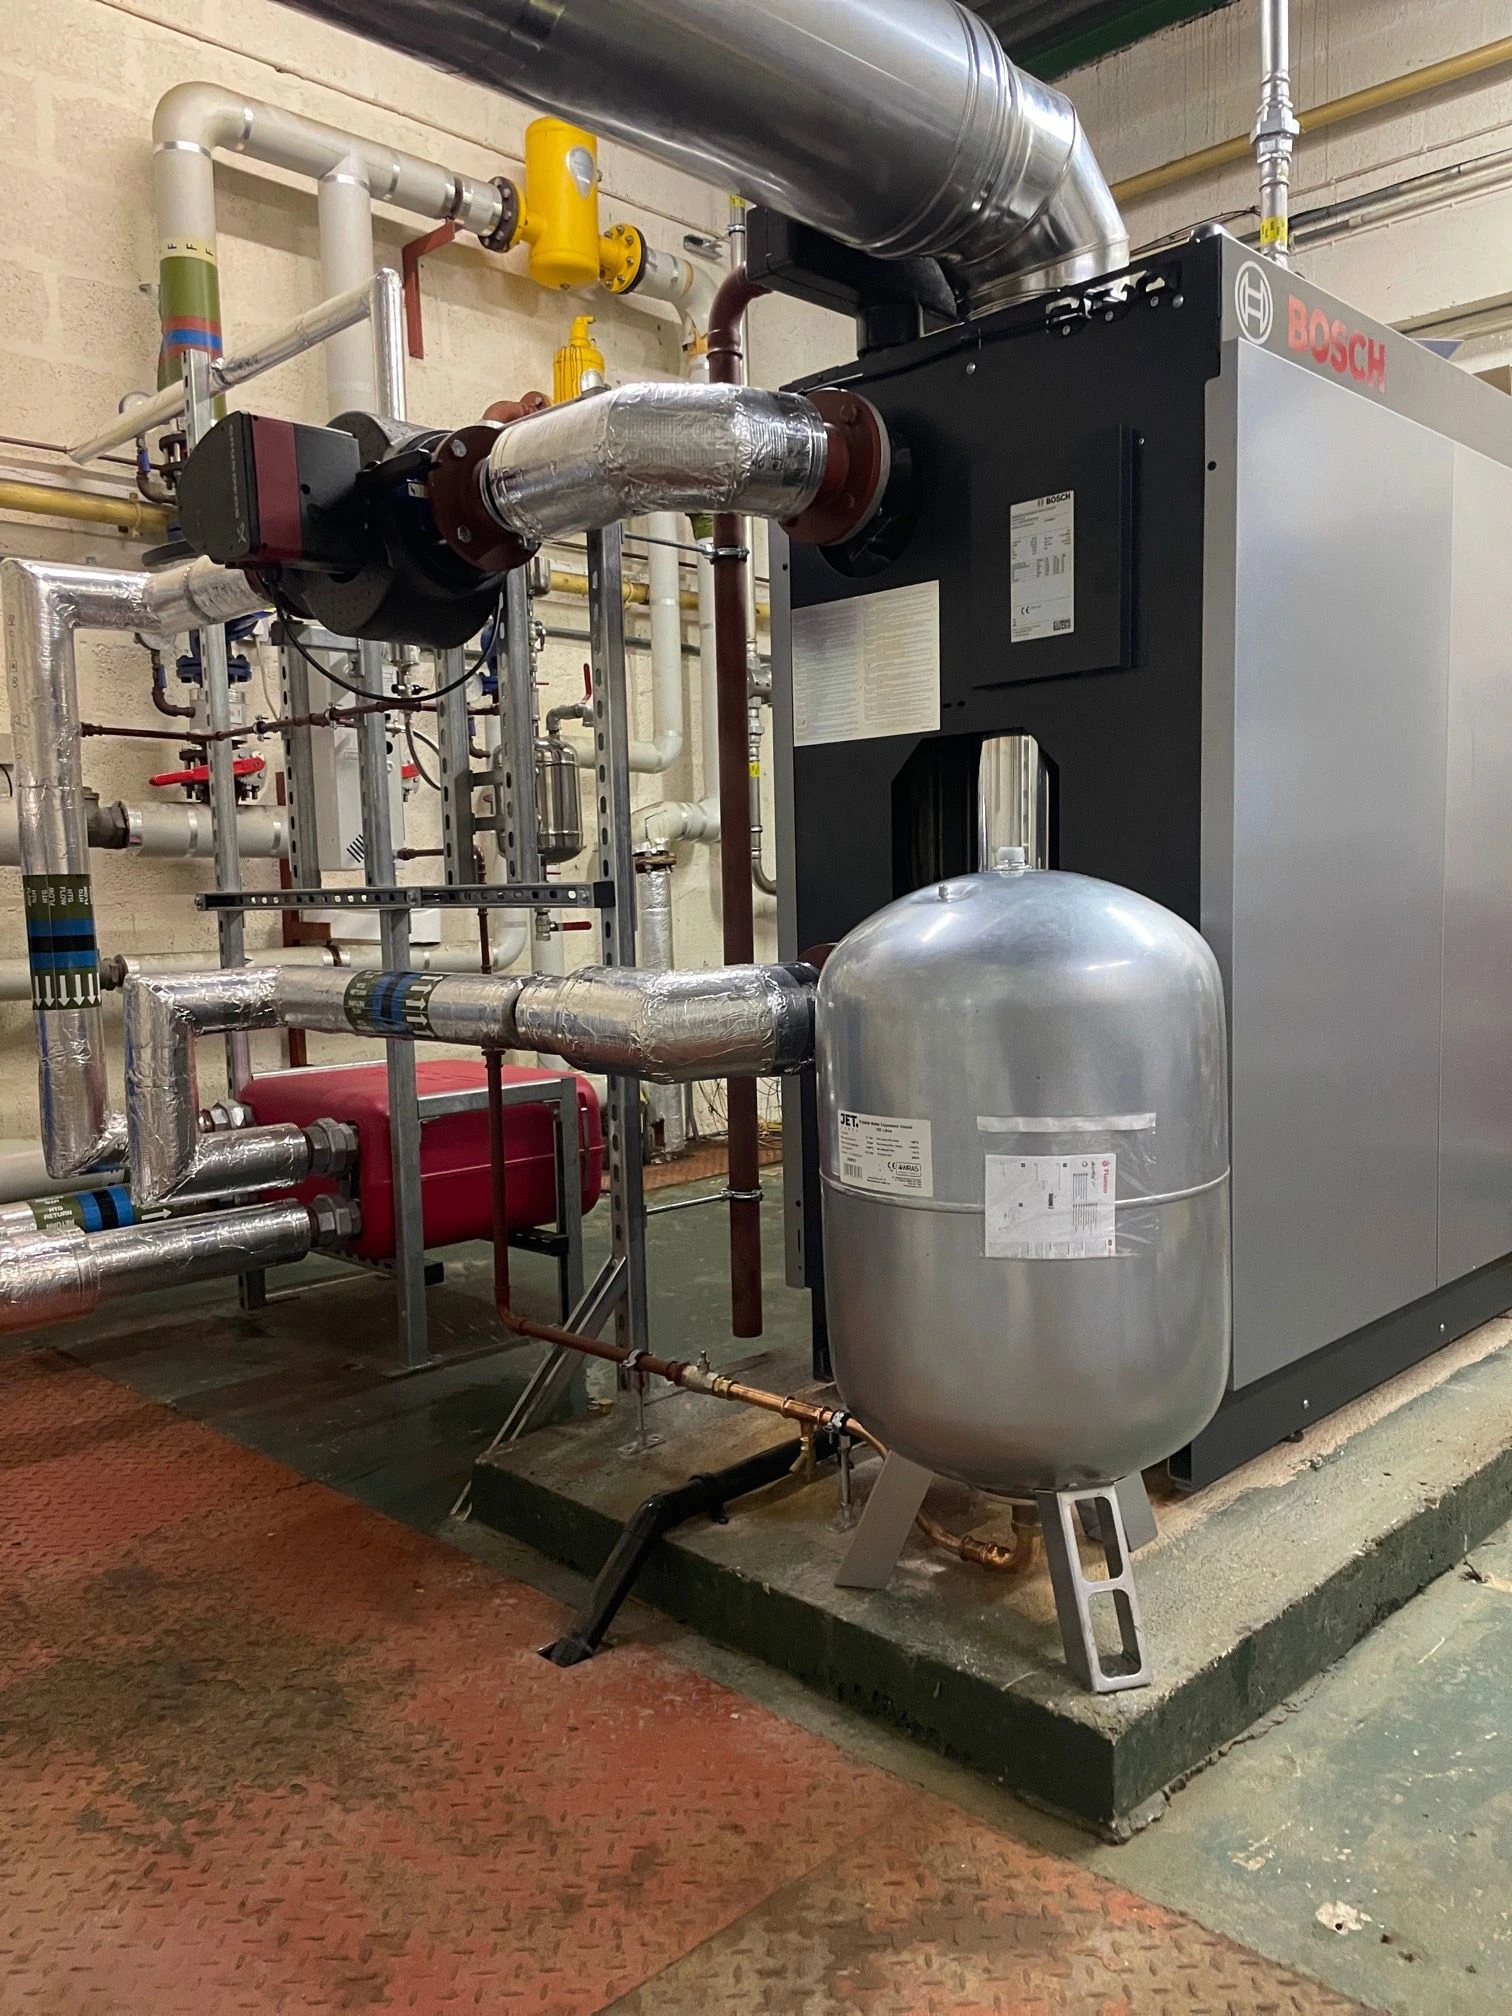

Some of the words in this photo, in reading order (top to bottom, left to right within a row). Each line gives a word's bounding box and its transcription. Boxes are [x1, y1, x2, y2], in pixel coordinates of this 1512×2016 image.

[1287, 294, 1386, 394] BOSCH
[1046, 492, 1071, 505] BOSCH
[59, 886, 67, 906] FLOW
[43, 1210, 73, 1220] RETURN
